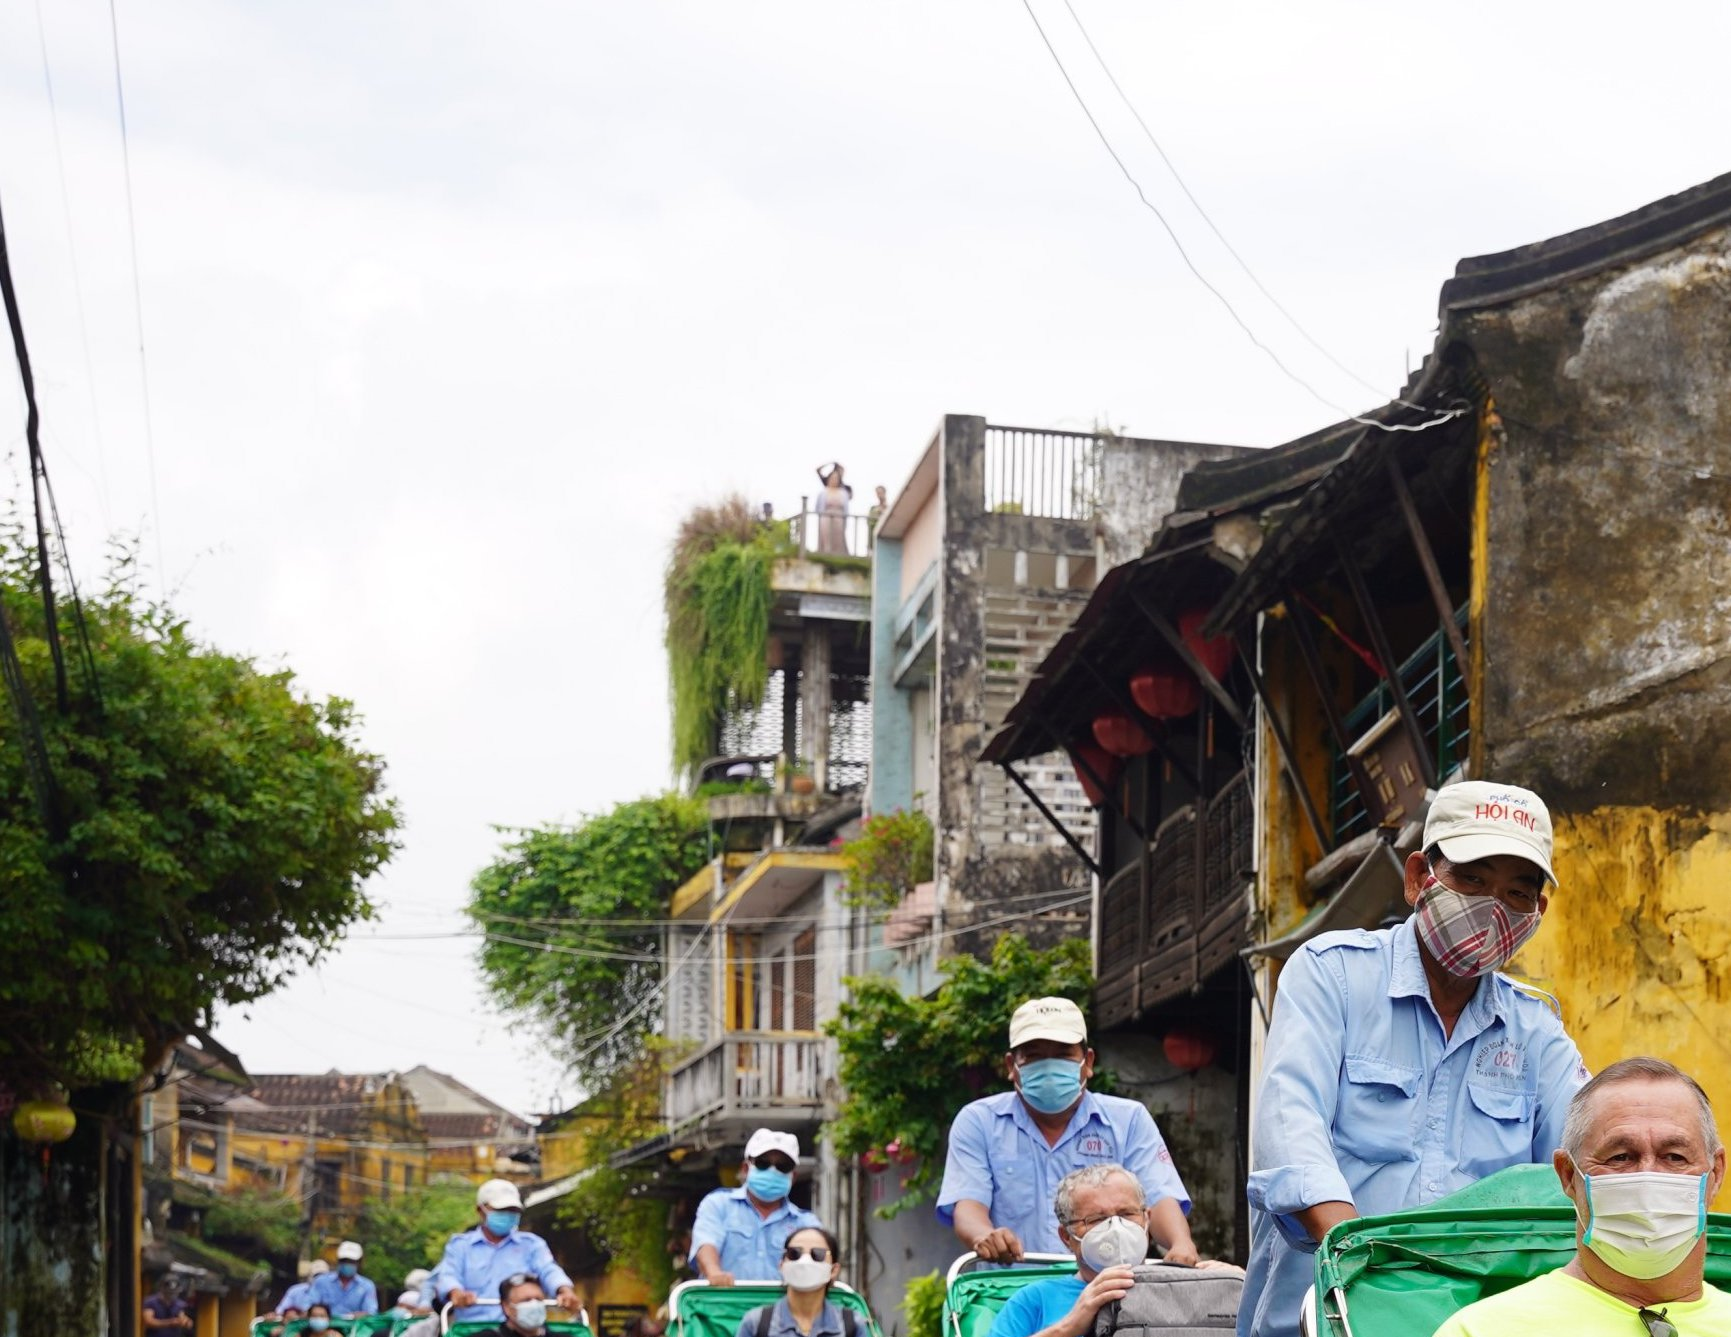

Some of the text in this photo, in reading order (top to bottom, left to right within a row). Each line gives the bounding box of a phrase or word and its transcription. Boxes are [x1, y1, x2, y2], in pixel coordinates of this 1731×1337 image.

[1475, 801, 1536, 832] HỘI AN
[1494, 1050, 1517, 1069] 027
